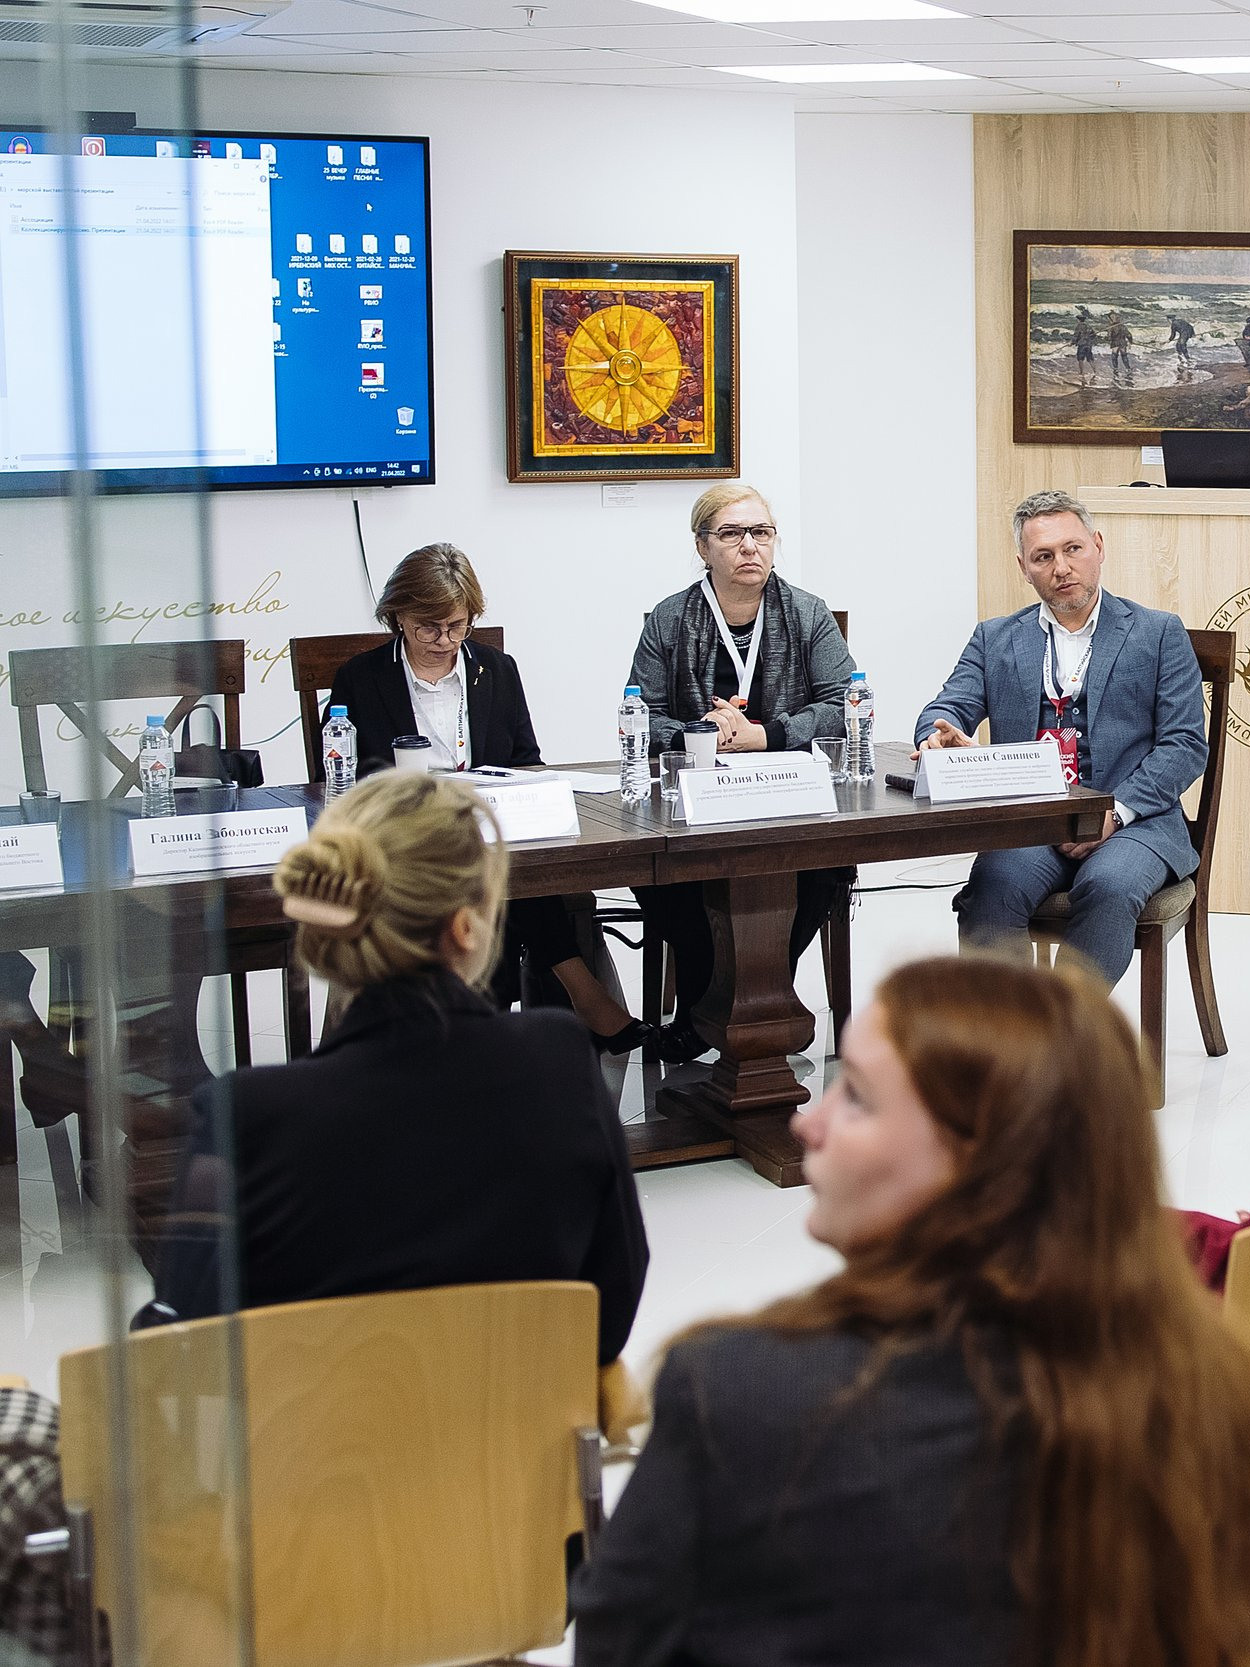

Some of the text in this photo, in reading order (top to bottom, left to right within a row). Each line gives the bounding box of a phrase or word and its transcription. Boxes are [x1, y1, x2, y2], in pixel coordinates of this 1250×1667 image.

[1210, 610, 1232, 631] ЕЙ
[946, 752, 990, 764] Алексей
[717, 771, 798, 786] Юлия Купина
[0, 836, 18, 847] ай
[150, 831, 202, 844] Галина
